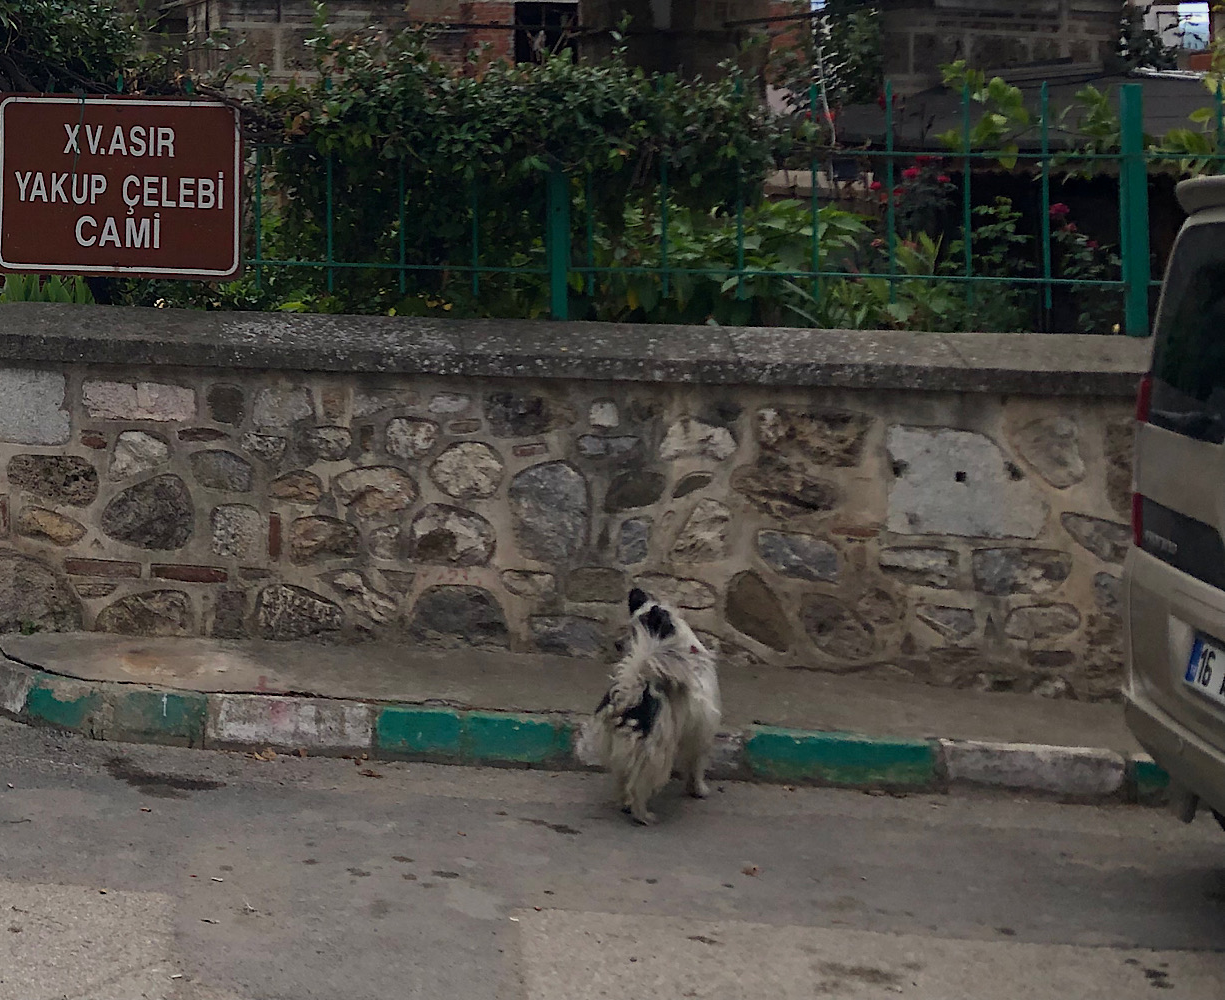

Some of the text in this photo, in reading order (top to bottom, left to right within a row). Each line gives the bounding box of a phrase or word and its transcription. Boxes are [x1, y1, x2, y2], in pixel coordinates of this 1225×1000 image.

[14, 170, 224, 215] YAKUP ÇELEBİ
[75, 212, 162, 249] CAMİ
[1197, 648, 1216, 687] 16
